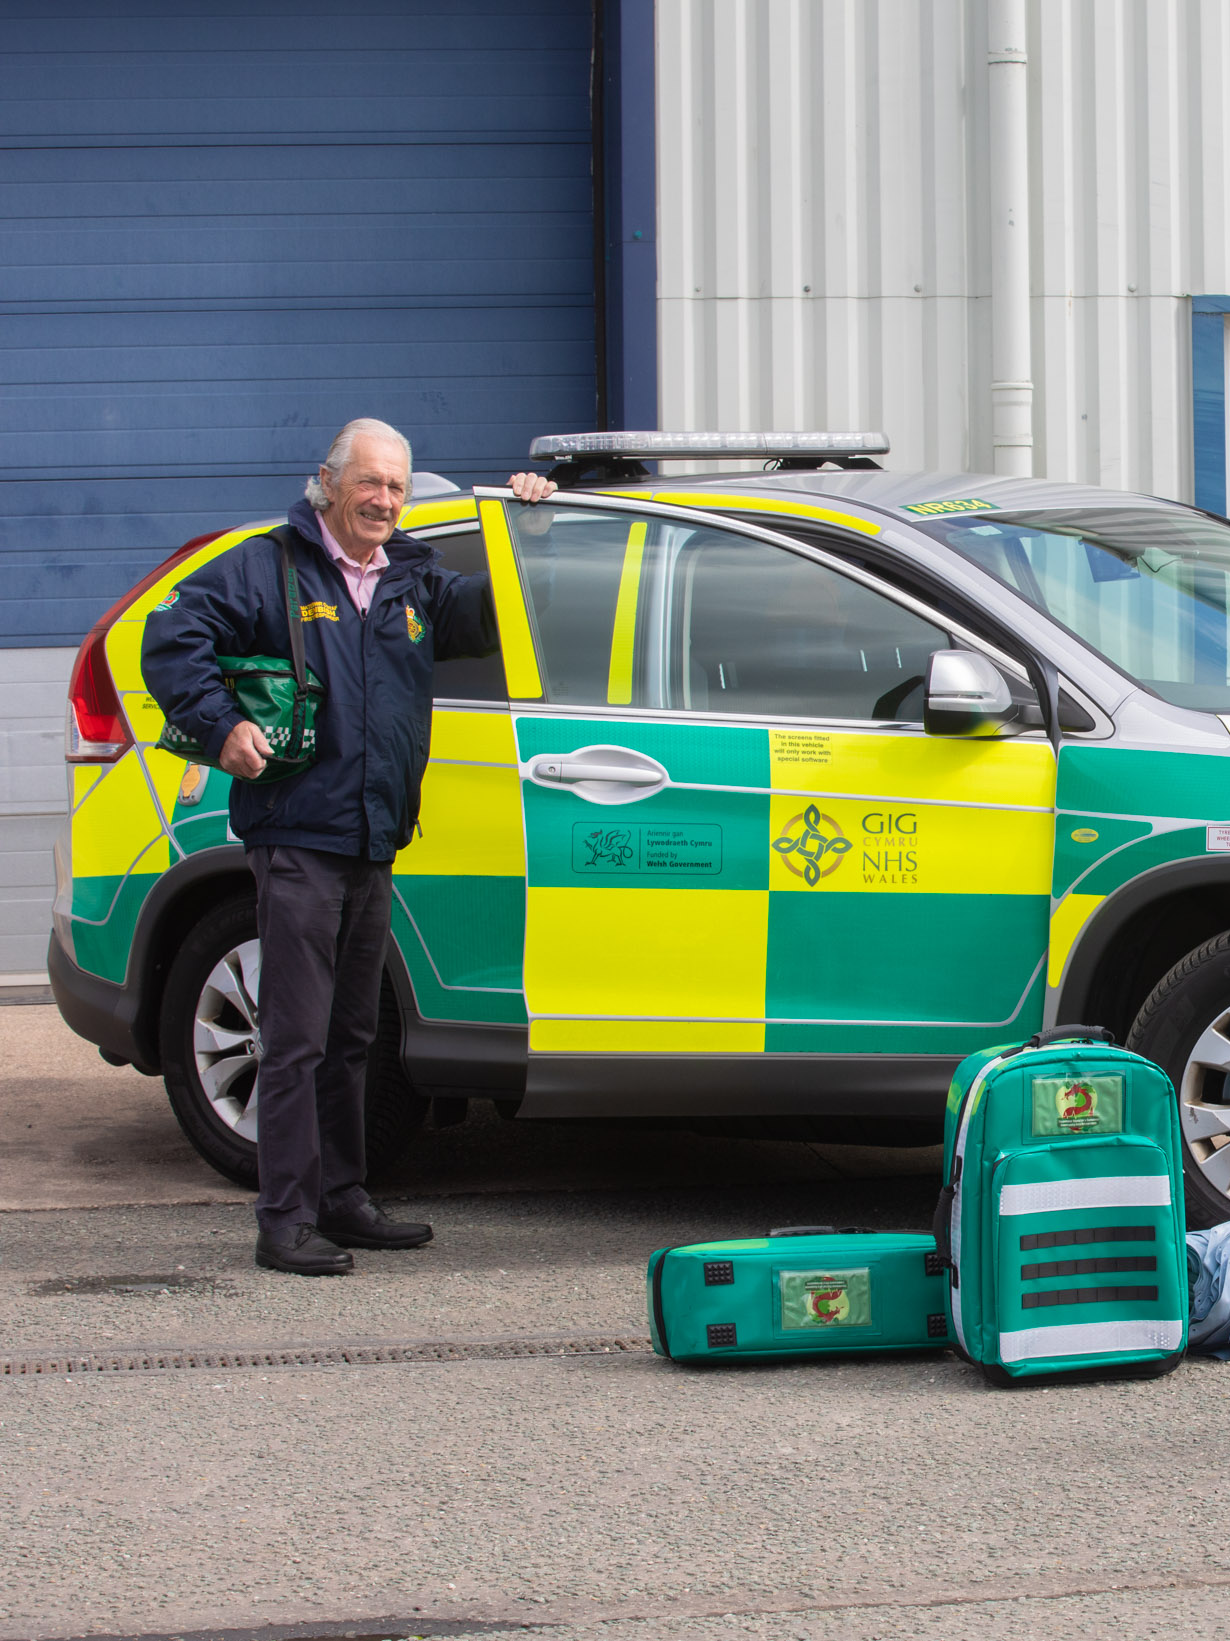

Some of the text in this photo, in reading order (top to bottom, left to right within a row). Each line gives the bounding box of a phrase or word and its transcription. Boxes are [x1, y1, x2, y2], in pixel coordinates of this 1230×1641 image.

[907, 499, 993, 515] NR634
[861, 812, 917, 835] GIG
[672, 831, 684, 839] gan
[647, 839, 713, 848] Lywodraeth Cymru
[862, 836, 918, 847] CYMRU
[670, 851, 678, 860] by
[862, 850, 918, 872] NHS
[862, 874, 918, 884] WALES
